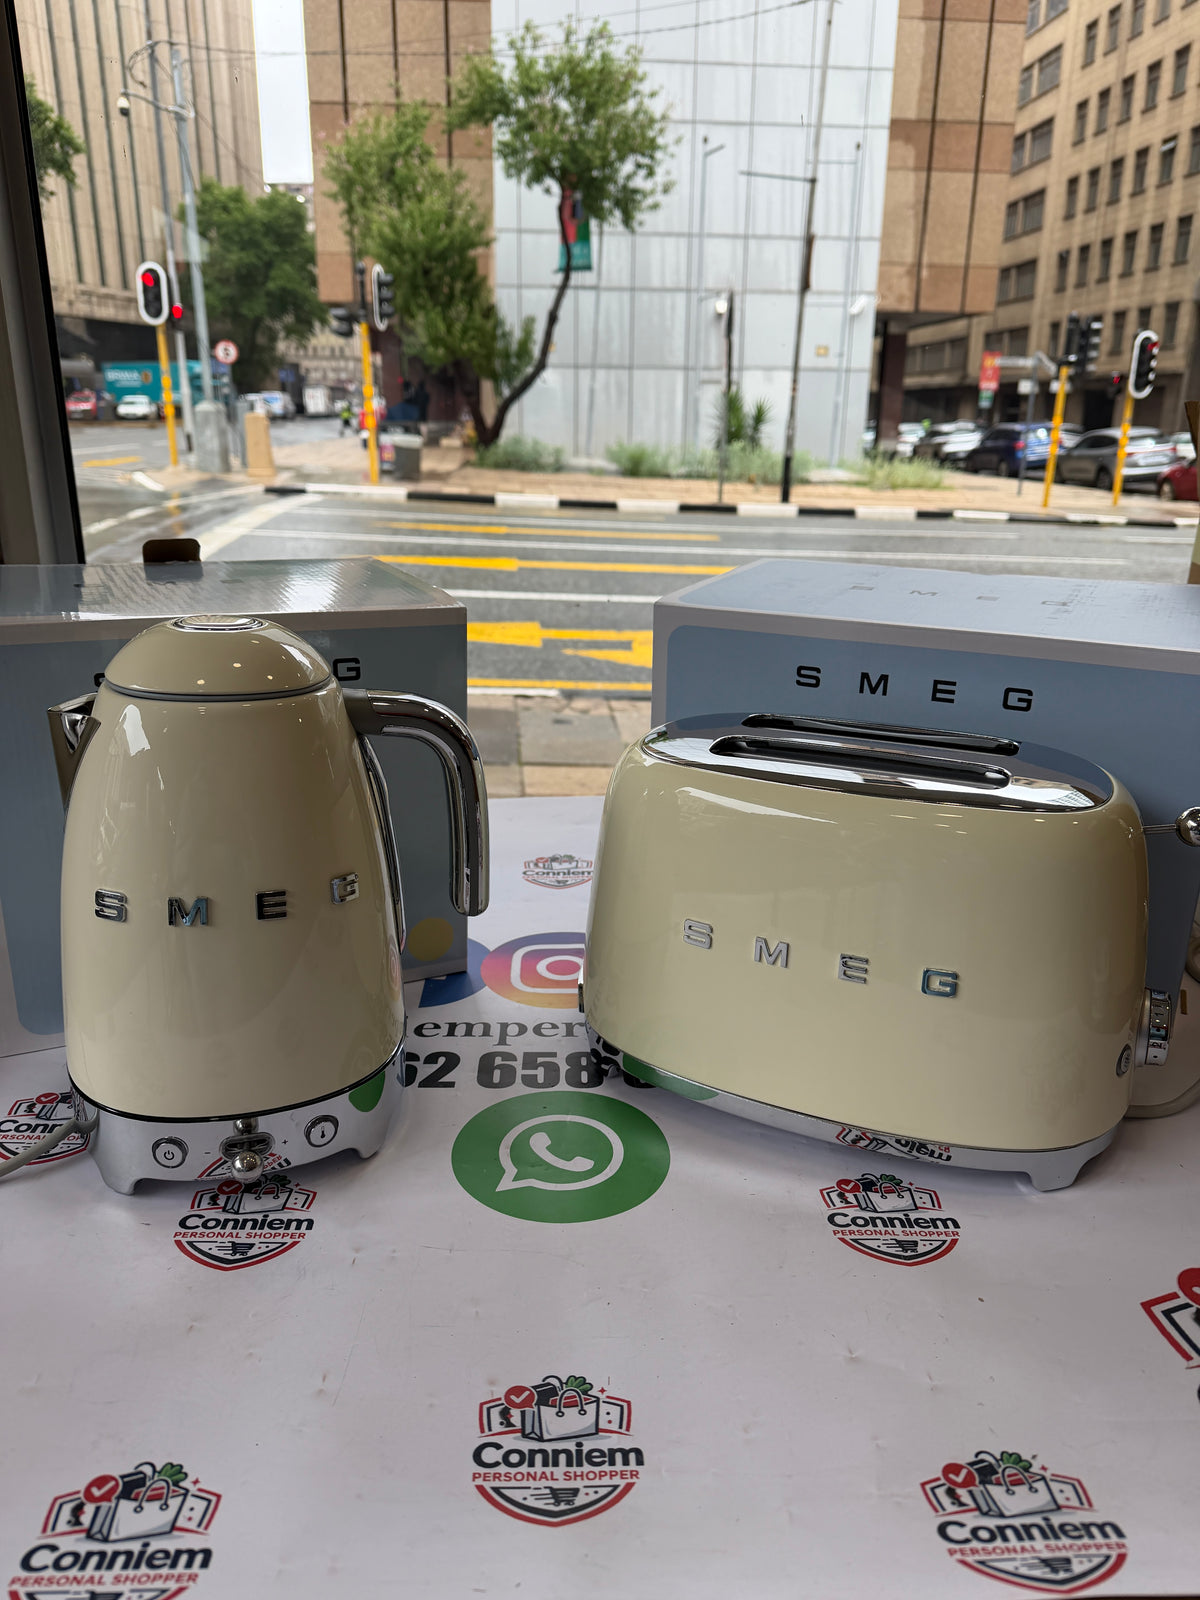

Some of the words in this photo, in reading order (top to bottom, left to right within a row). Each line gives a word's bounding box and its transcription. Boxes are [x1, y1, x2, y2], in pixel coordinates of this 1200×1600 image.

[796, 665, 1033, 712] SMEG
[95, 871, 360, 927] SMEG
[683, 918, 958, 998] SMEG
[405, 1015, 587, 1046] emper
[0, 1119, 63, 1133] Conn
[178, 1214, 314, 1231] Conniem
[827, 1212, 961, 1229] Conniem
[173, 1231, 242, 1239] PERSONAL
[245, 1232, 306, 1240] SHOPPER
[832, 1229, 899, 1237] PERSONAL
[902, 1229, 960, 1237] SHOPPER
[472, 1441, 644, 1468] Conniem
[472, 1471, 559, 1482] PERSONAL
[563, 1470, 640, 1481] SHOPPER
[937, 1516, 1127, 1544] Conniem
[20, 1541, 213, 1573] Conniem
[947, 1545, 1040, 1557] PERSONAL
[1044, 1541, 1128, 1554] SHOPPER
[8, 1574, 108, 1587] PERSONAL
[112, 1572, 199, 1586] SHOPPER
